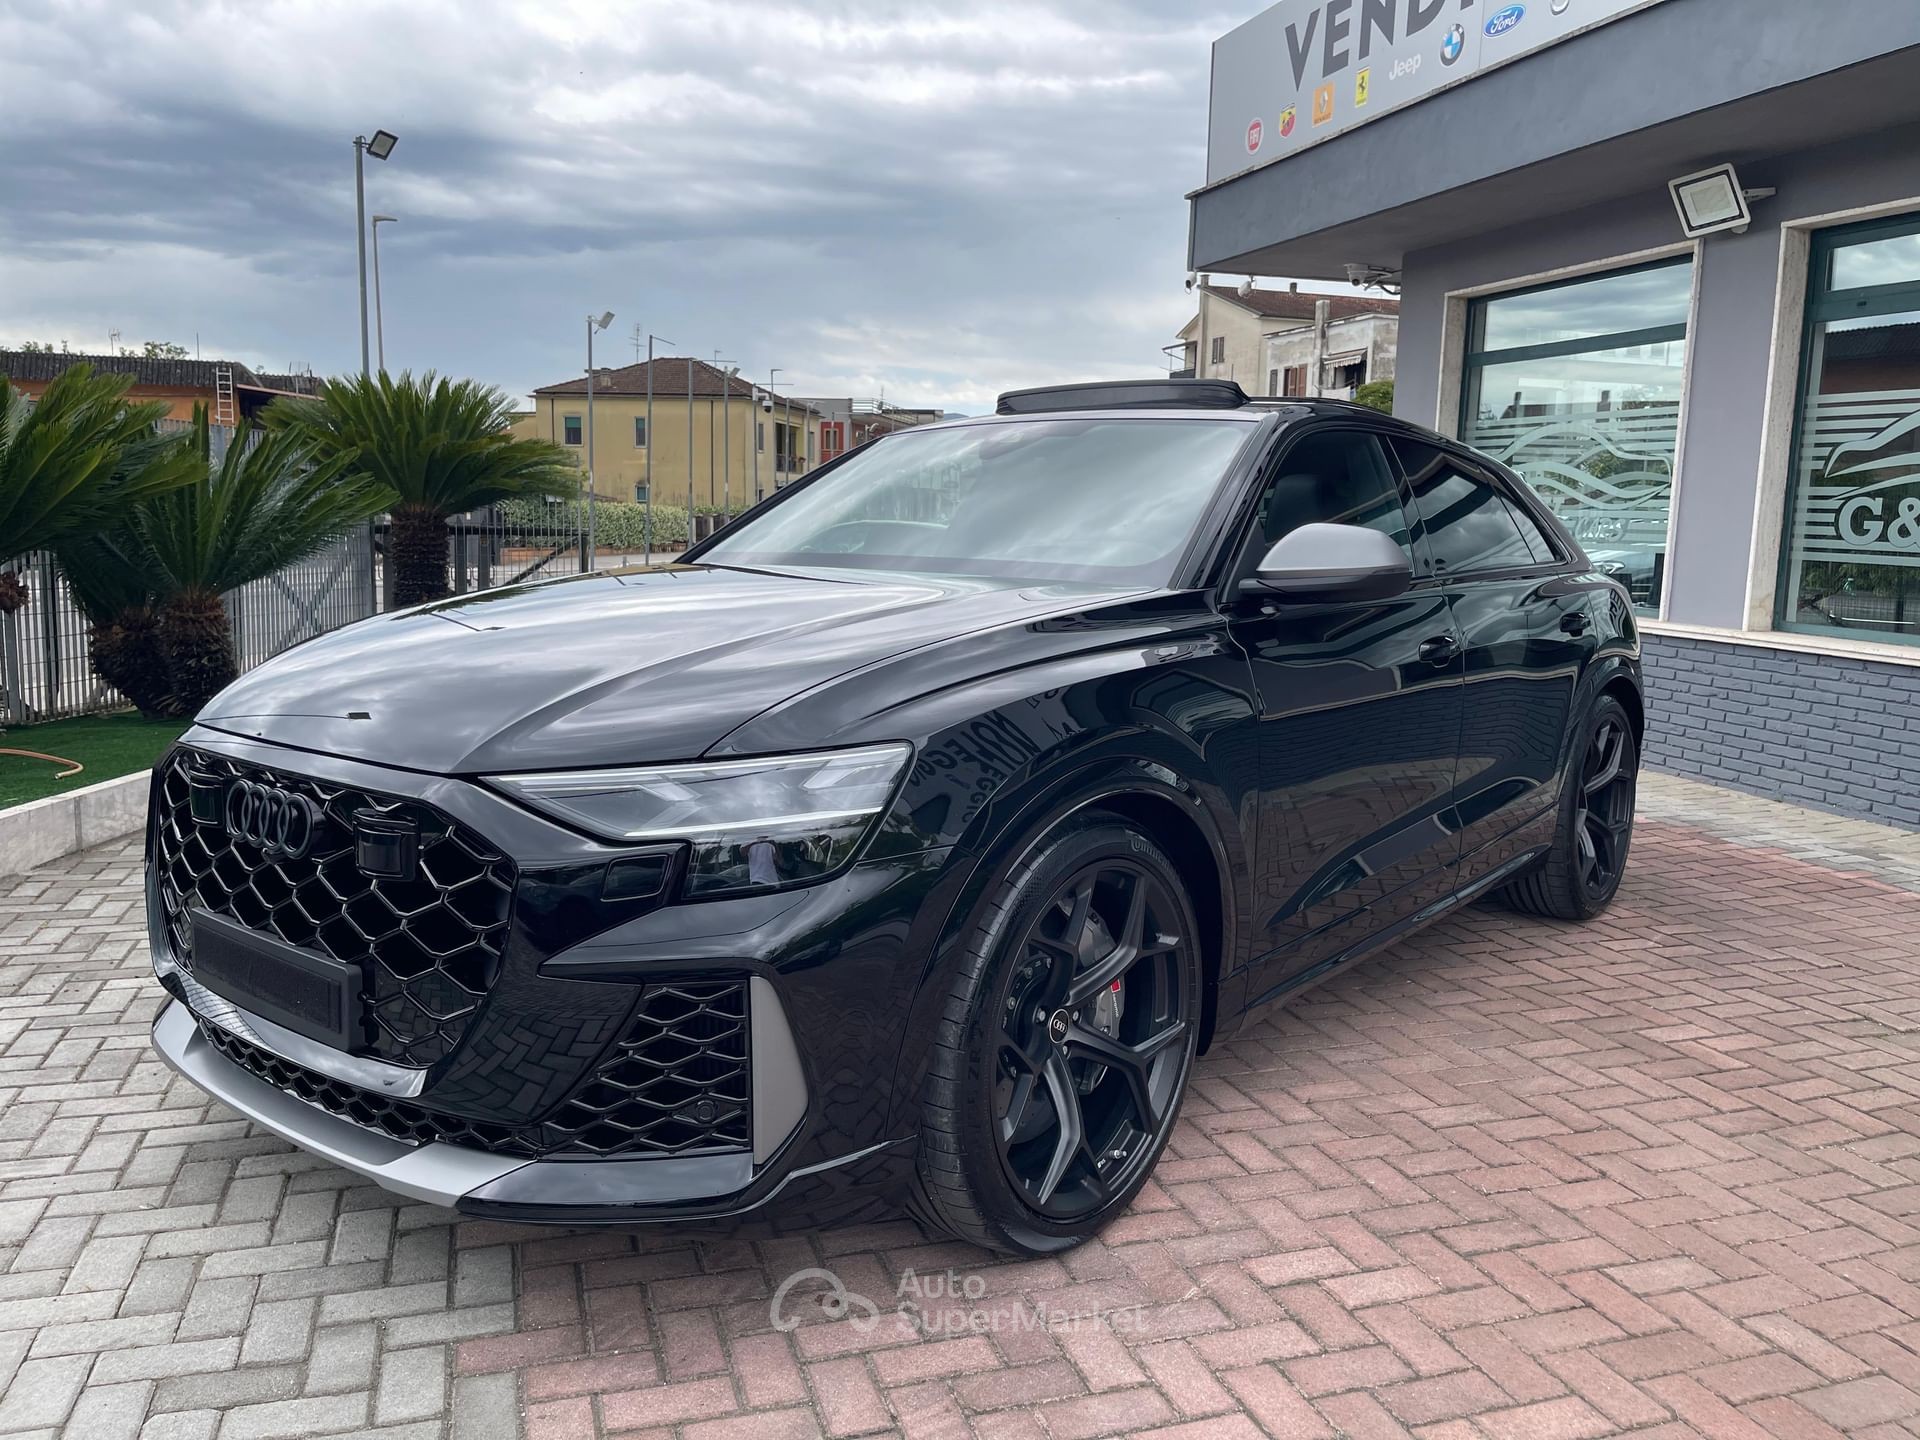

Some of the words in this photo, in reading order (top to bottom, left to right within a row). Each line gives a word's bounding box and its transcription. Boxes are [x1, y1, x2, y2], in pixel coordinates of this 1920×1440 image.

[1490, 9, 1518, 34] Ford
[1285, 0, 1474, 92] VEN
[1389, 53, 1422, 80] Jeep
